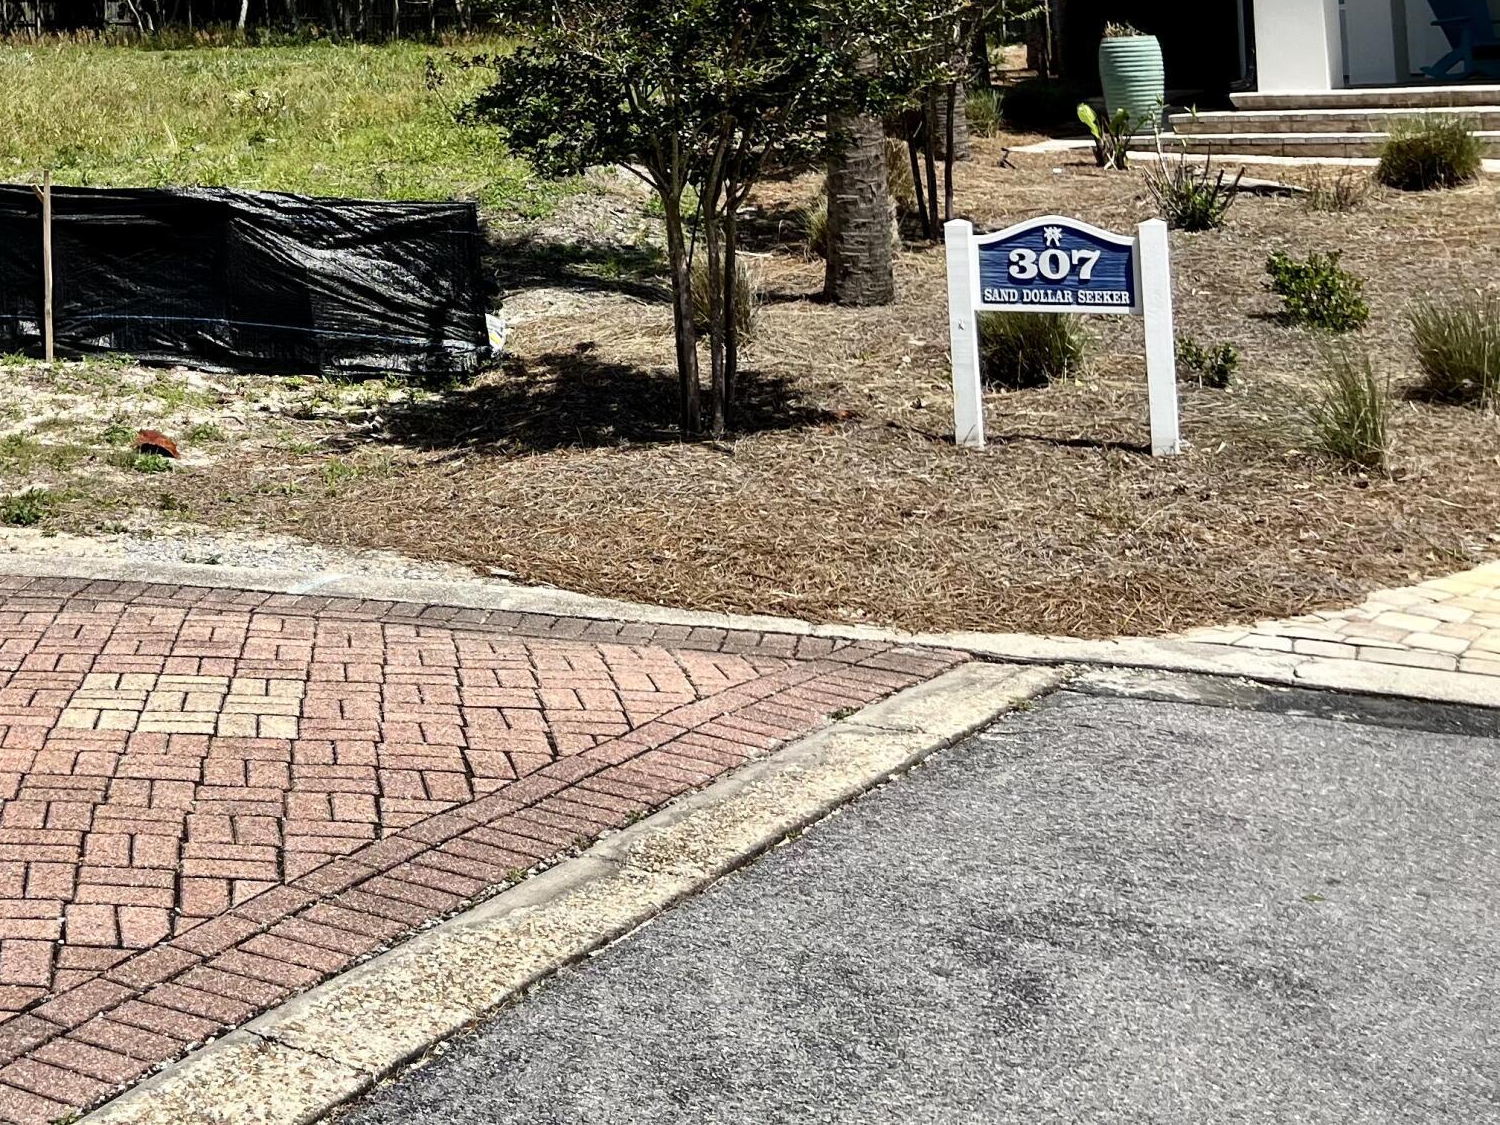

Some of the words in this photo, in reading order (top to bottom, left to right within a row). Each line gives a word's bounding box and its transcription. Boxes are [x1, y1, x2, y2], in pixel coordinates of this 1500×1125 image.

[1008, 248, 1101, 280] 307
[984, 289, 1018, 302] SAND
[1022, 289, 1073, 303] DOLLAR
[1077, 290, 1130, 304] SEEKER
